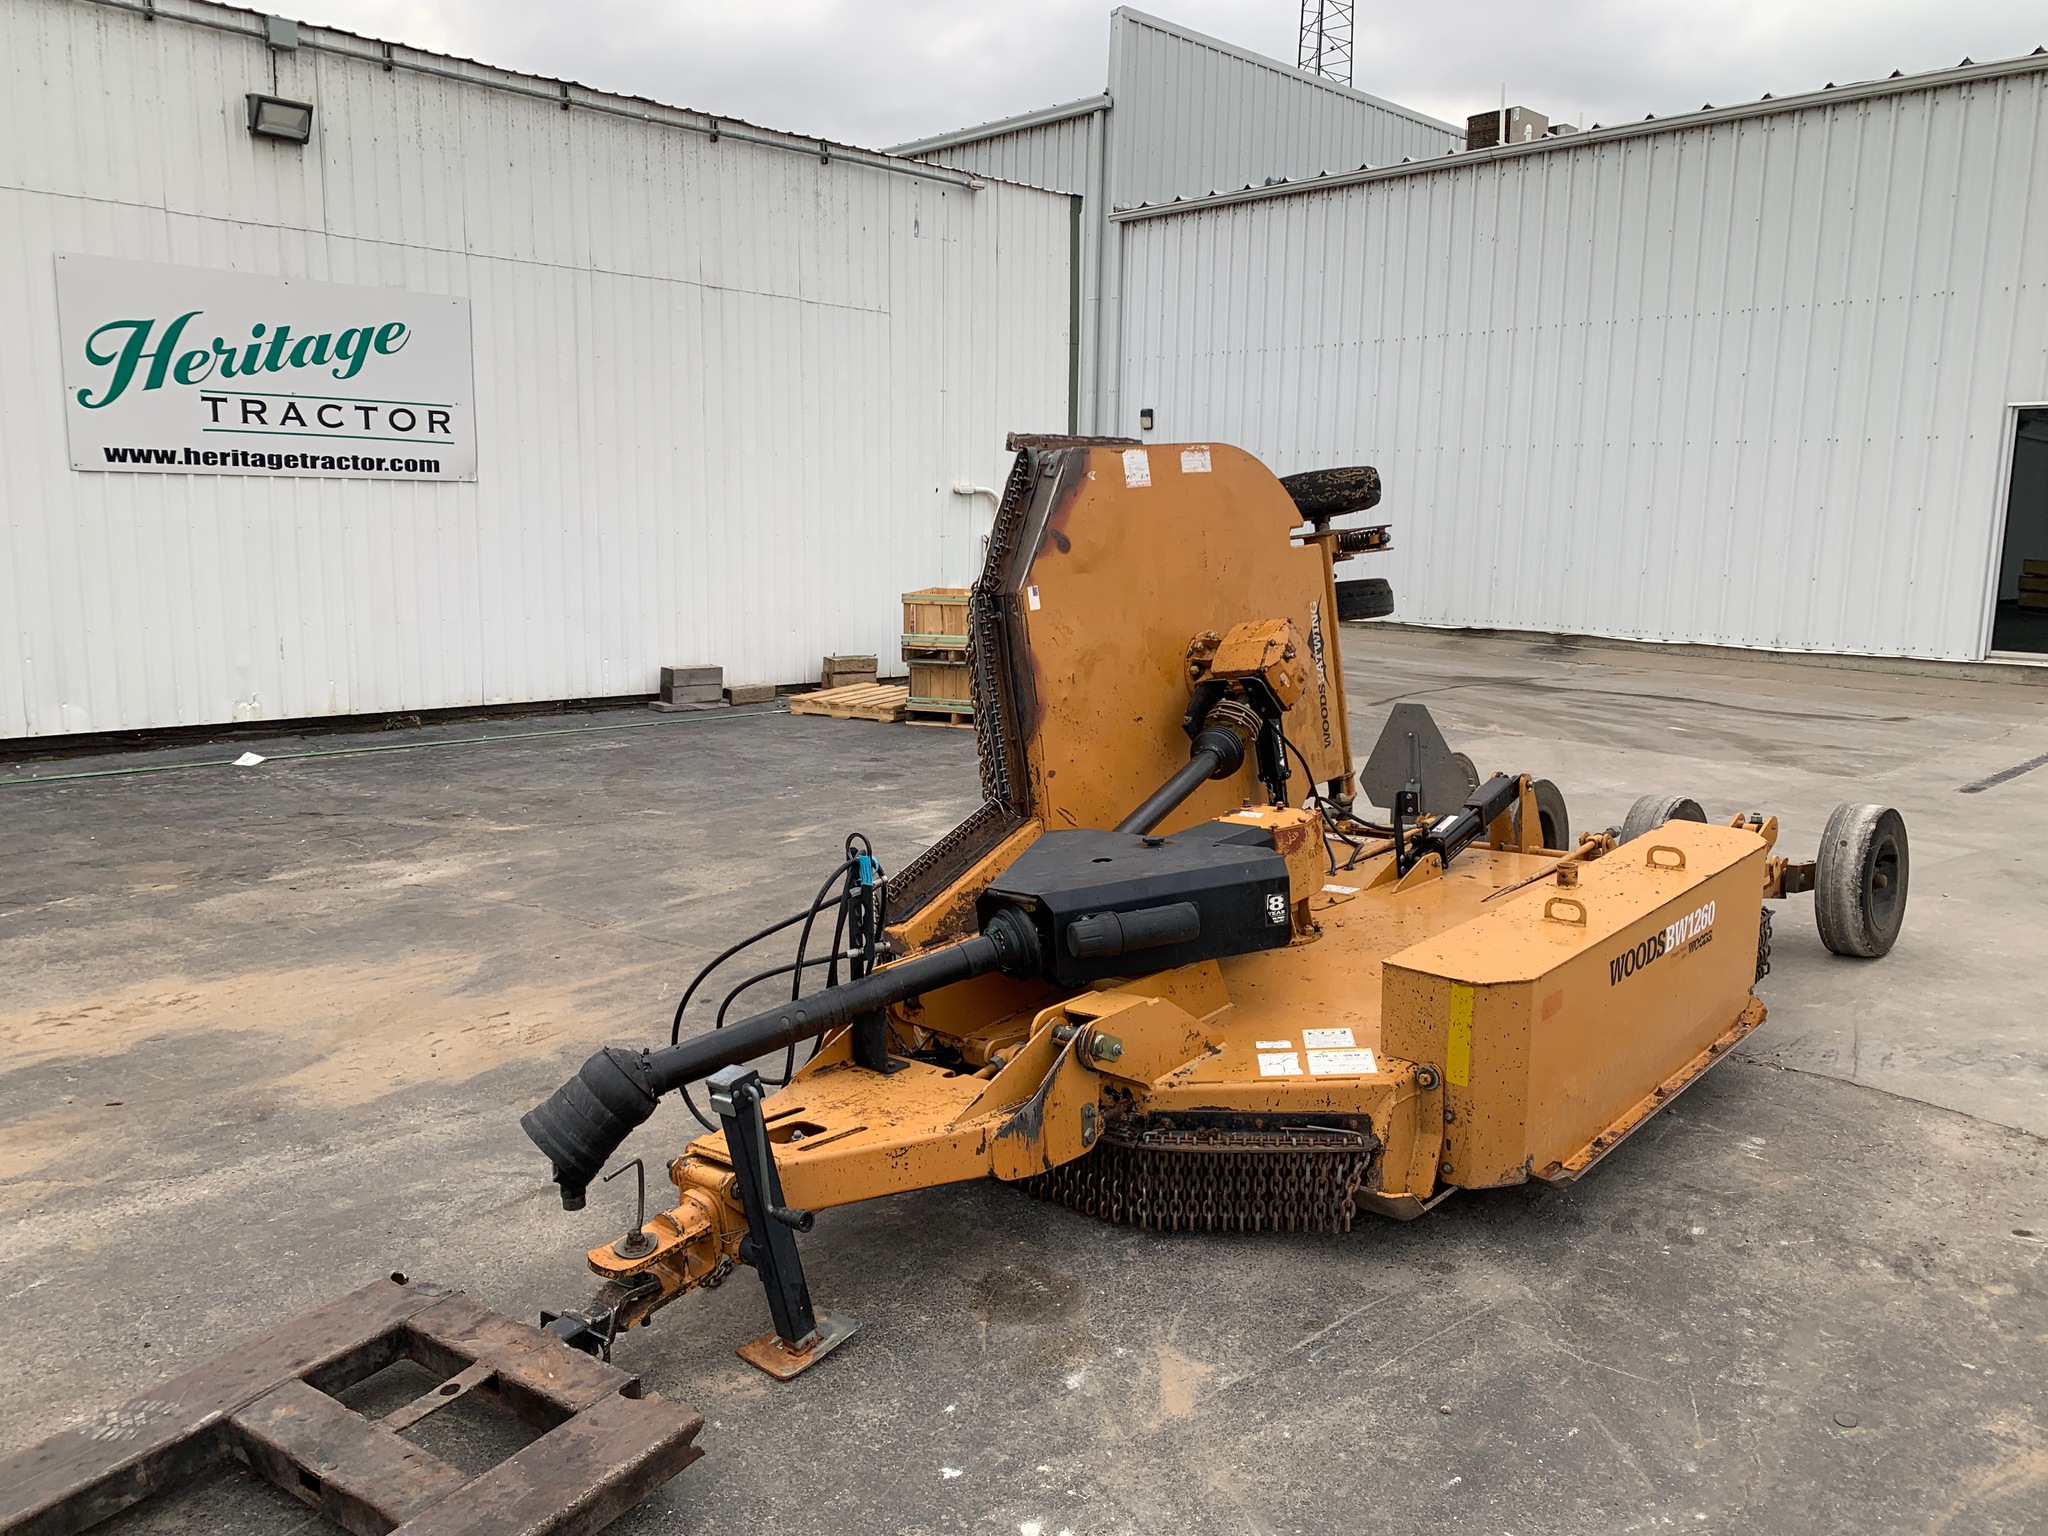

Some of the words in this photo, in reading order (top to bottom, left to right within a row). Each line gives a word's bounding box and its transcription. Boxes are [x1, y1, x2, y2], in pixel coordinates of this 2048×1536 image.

[77, 311, 411, 409] Heritage
[200, 394, 452, 435] TRACTOR
[103, 446, 440, 473] www.heritagetractor.com
[1317, 683, 1332, 749] WOODS
[1269, 896, 1285, 911] 8
[1609, 929, 1667, 987] WOODS
[1664, 899, 1716, 954] BW1260
